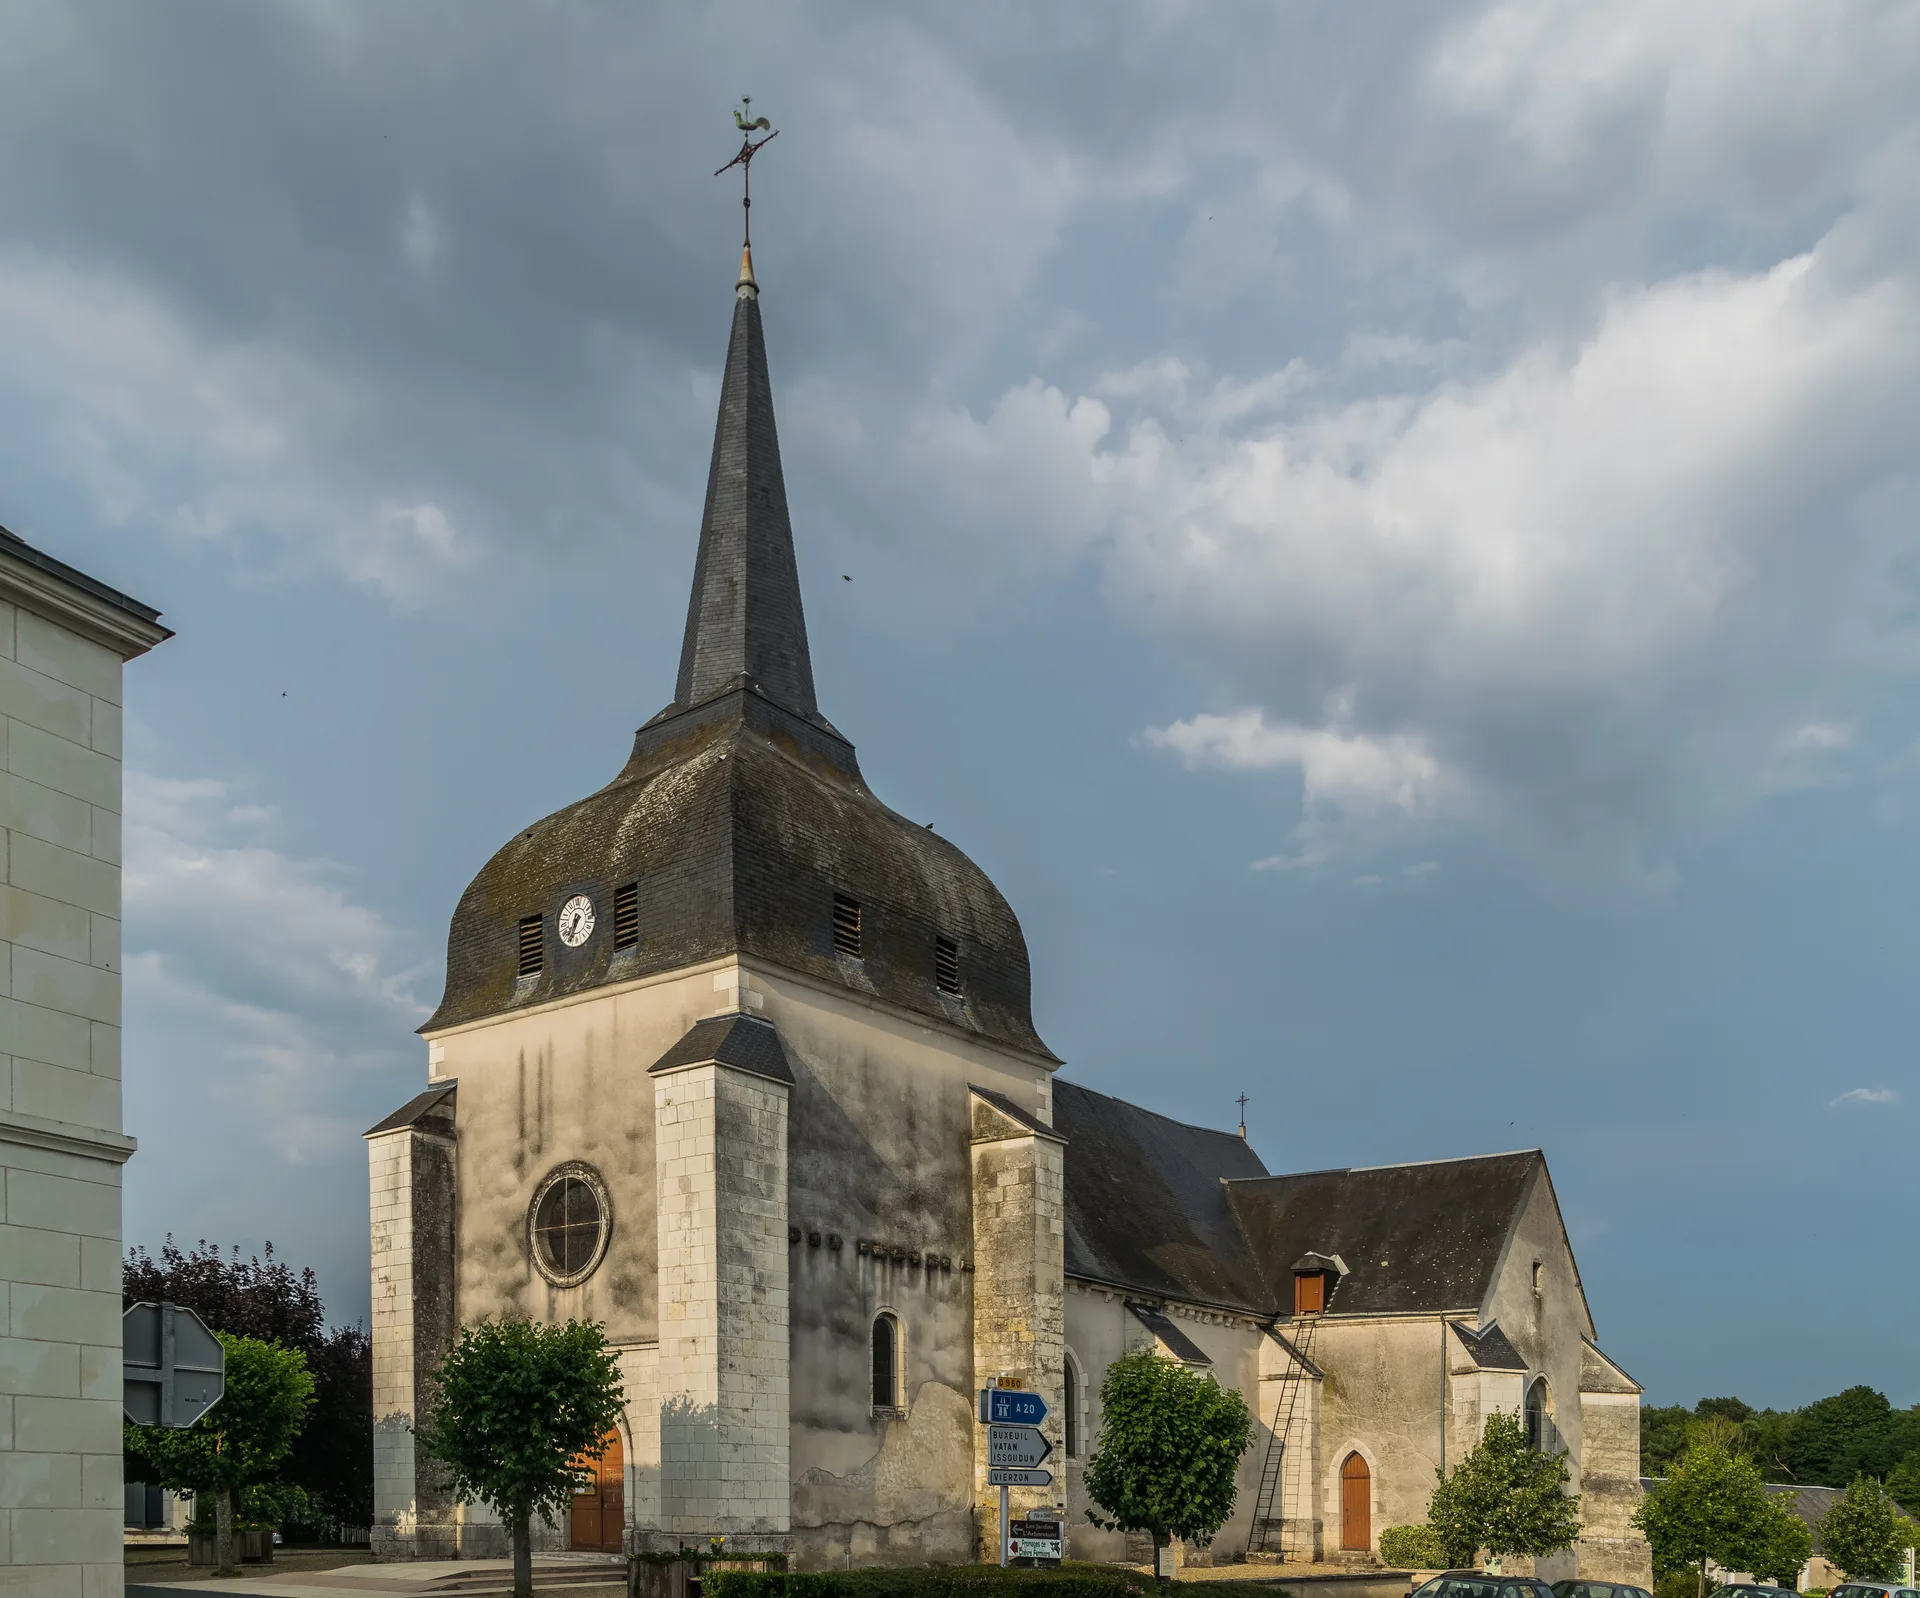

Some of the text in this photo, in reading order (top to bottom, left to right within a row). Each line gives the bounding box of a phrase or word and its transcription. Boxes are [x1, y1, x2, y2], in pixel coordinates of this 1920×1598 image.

[1006, 1379, 1021, 1388] 960
[1016, 1403, 1035, 1414] A 20
[993, 1431, 1028, 1440] BUXEUIL
[993, 1443, 1018, 1451] VATAN
[993, 1454, 1035, 1463] ISSOUDUN
[993, 1473, 1029, 1482] VIERZON
[1023, 1530, 1057, 1538] L'Arboretum
